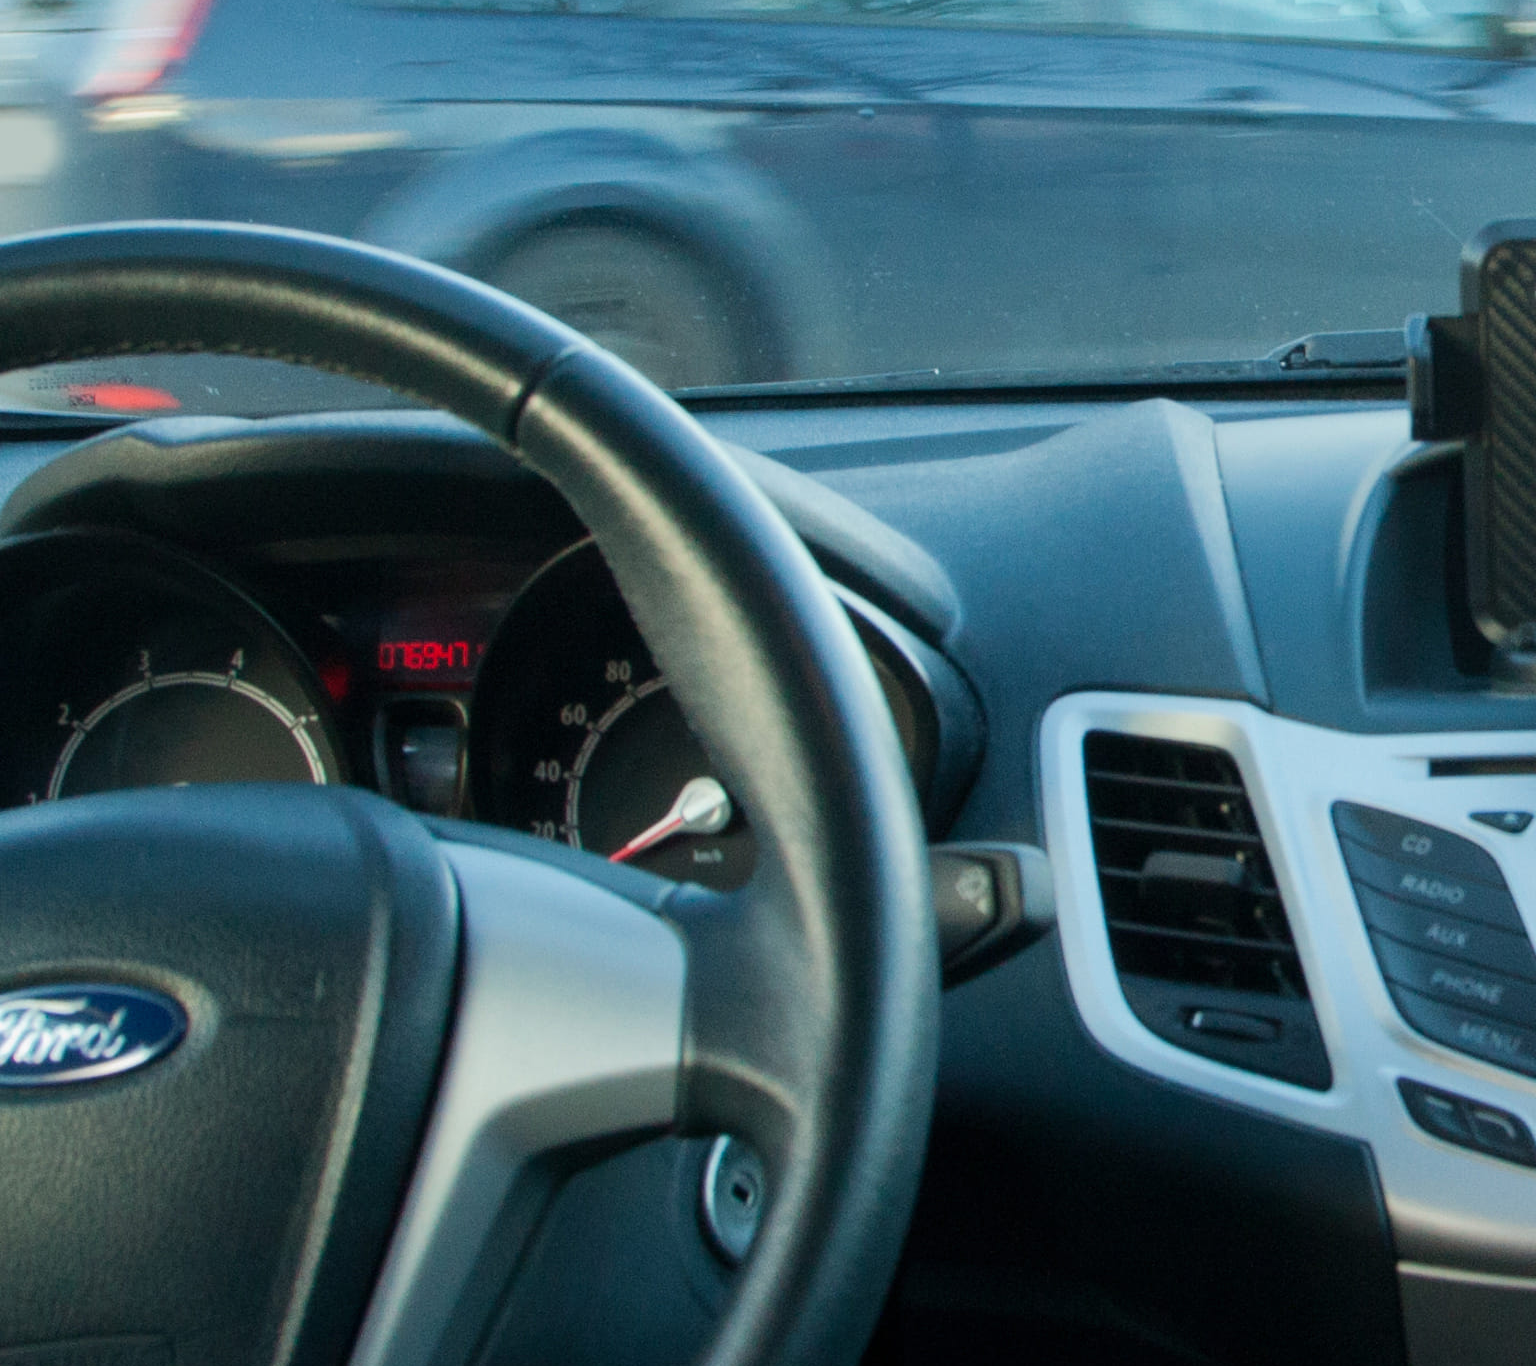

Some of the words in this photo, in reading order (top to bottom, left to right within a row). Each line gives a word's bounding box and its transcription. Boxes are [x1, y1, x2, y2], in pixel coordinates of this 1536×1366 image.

[139, 649, 151, 671] 3
[231, 648, 244, 671] 4
[378, 640, 469, 670] 076947
[606, 660, 631, 682] 80
[58, 703, 70, 726] 2
[561, 703, 587, 726] 60
[534, 760, 561, 783] 40
[1401, 834, 1433, 856] CD
